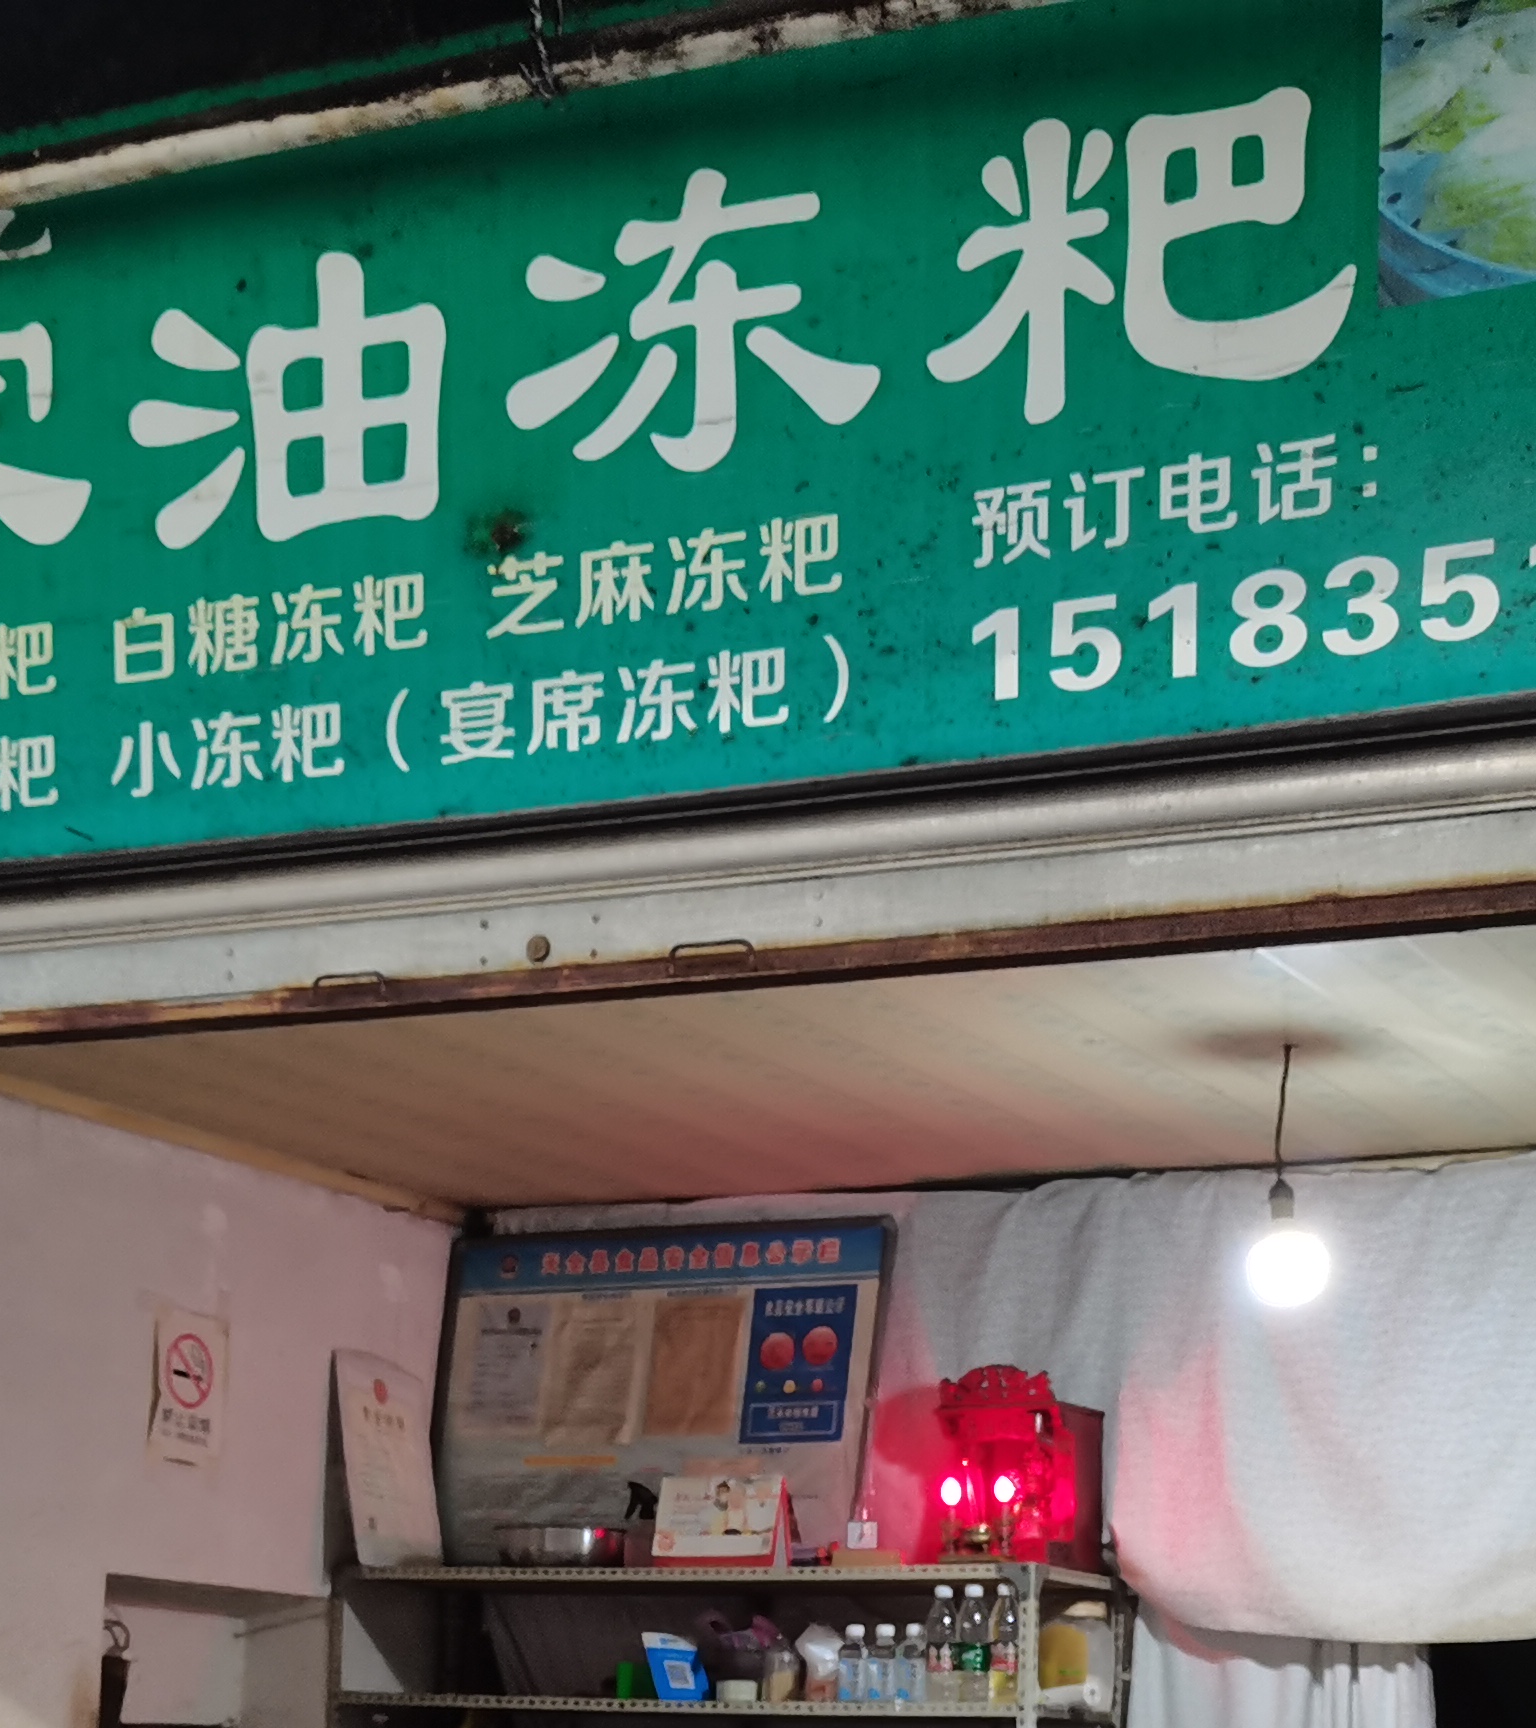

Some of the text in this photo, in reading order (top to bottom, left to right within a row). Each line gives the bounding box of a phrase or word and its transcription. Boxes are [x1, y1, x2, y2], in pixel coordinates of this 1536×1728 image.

[113, 573, 428, 684] 白糖冻粑
[486, 513, 842, 639] 芝麻冻粑
